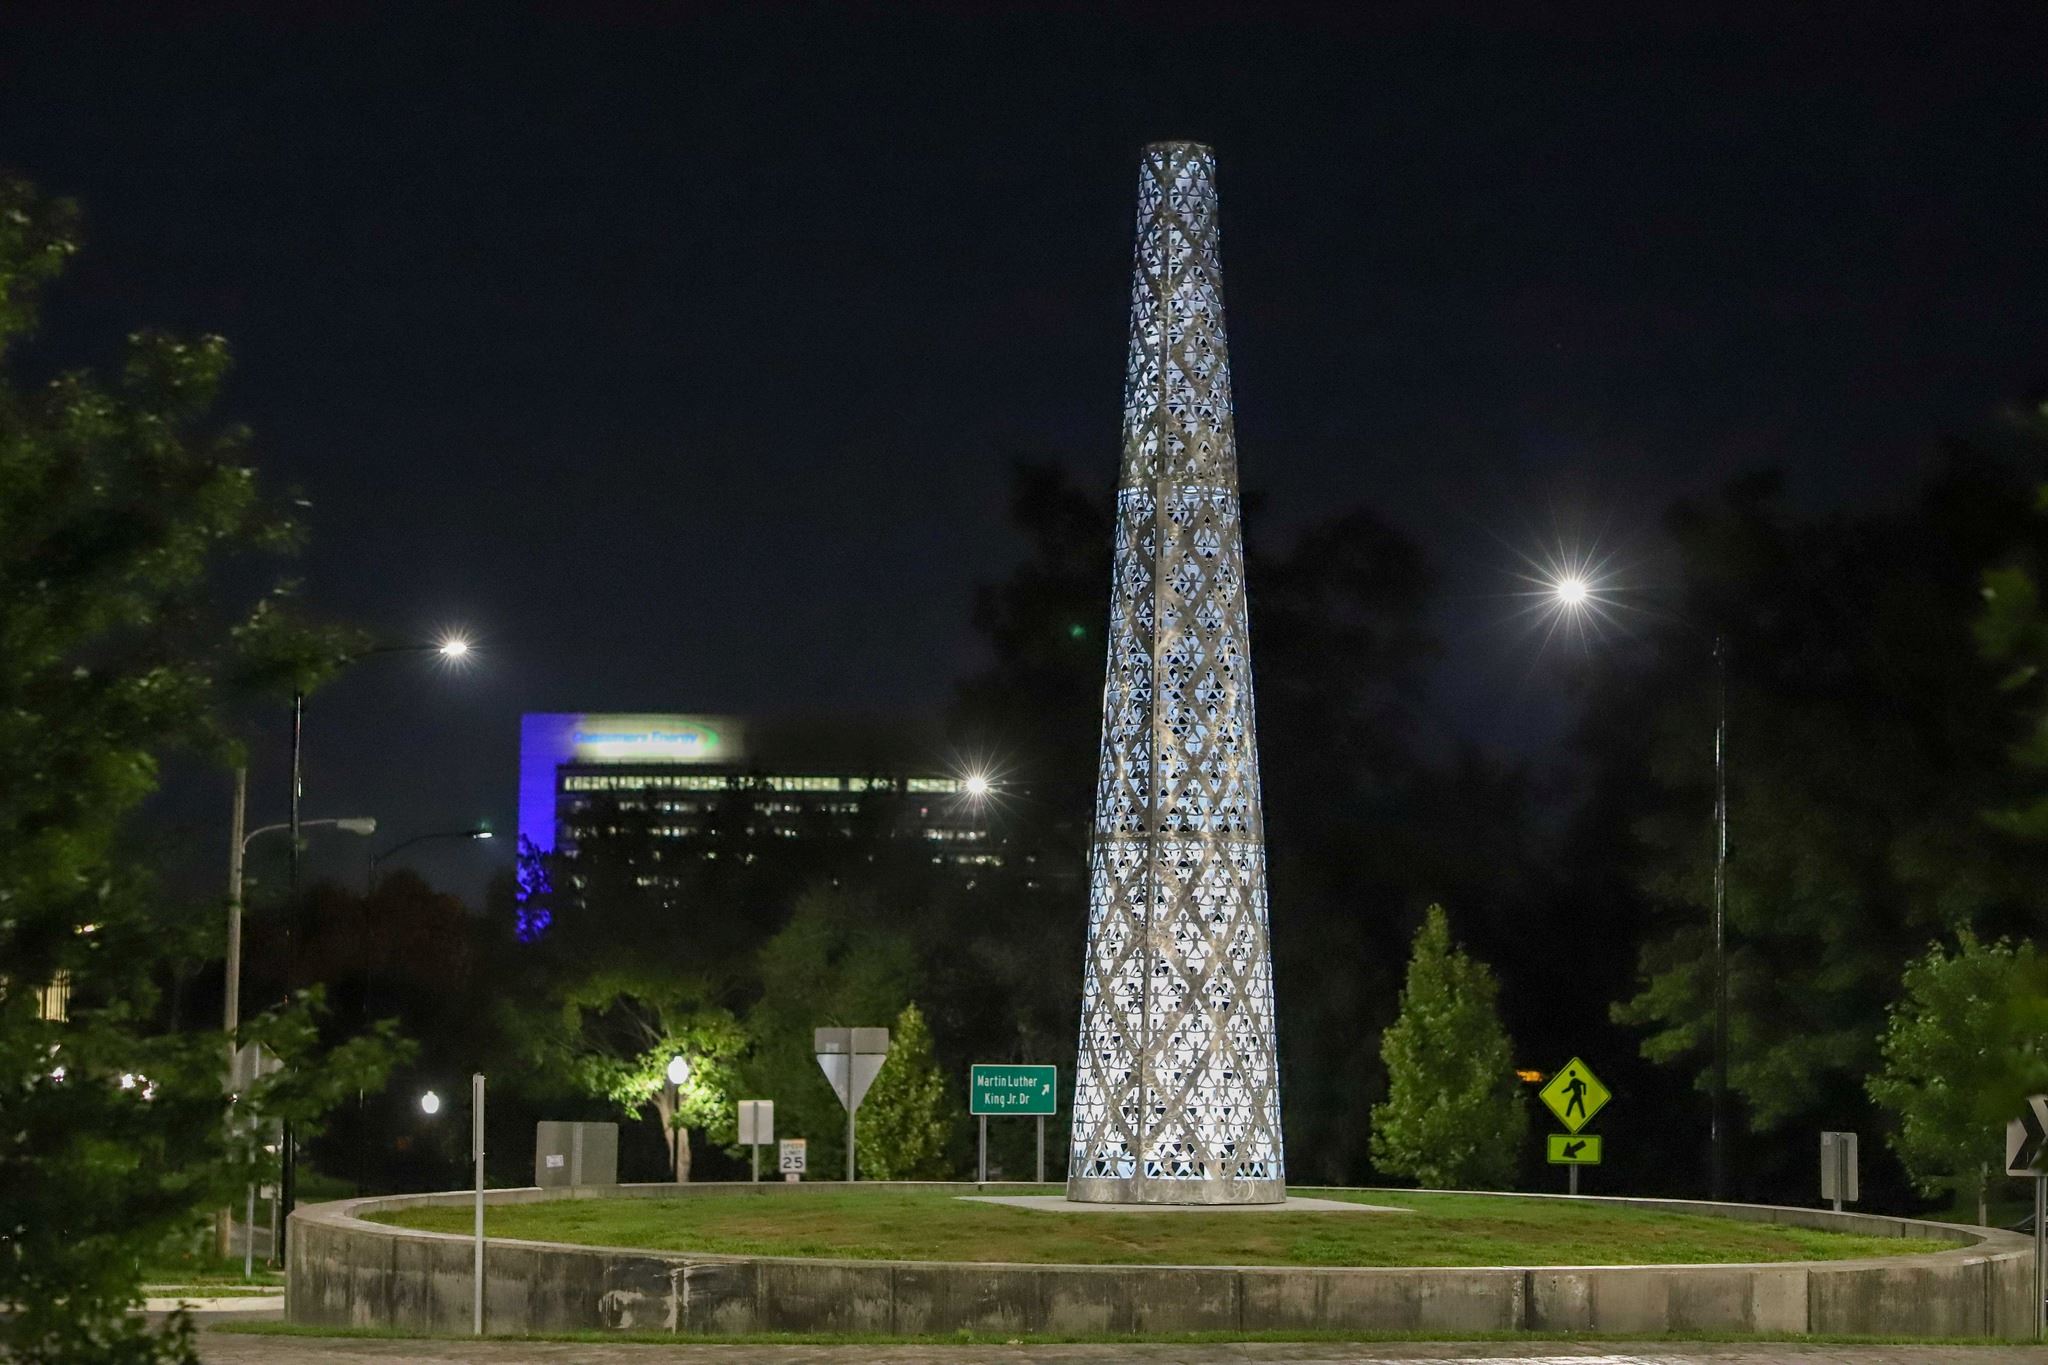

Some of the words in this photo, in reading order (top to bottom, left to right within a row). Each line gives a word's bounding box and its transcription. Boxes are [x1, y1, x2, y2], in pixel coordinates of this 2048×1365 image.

[977, 1075, 1006, 1087] Martin
[1008, 1075, 1037, 1087] Luther
[984, 1092, 1005, 1107] King
[1007, 1093, 1018, 1104] Jr.
[1019, 1093, 1030, 1104] Dr
[783, 1156, 803, 1168] 25
